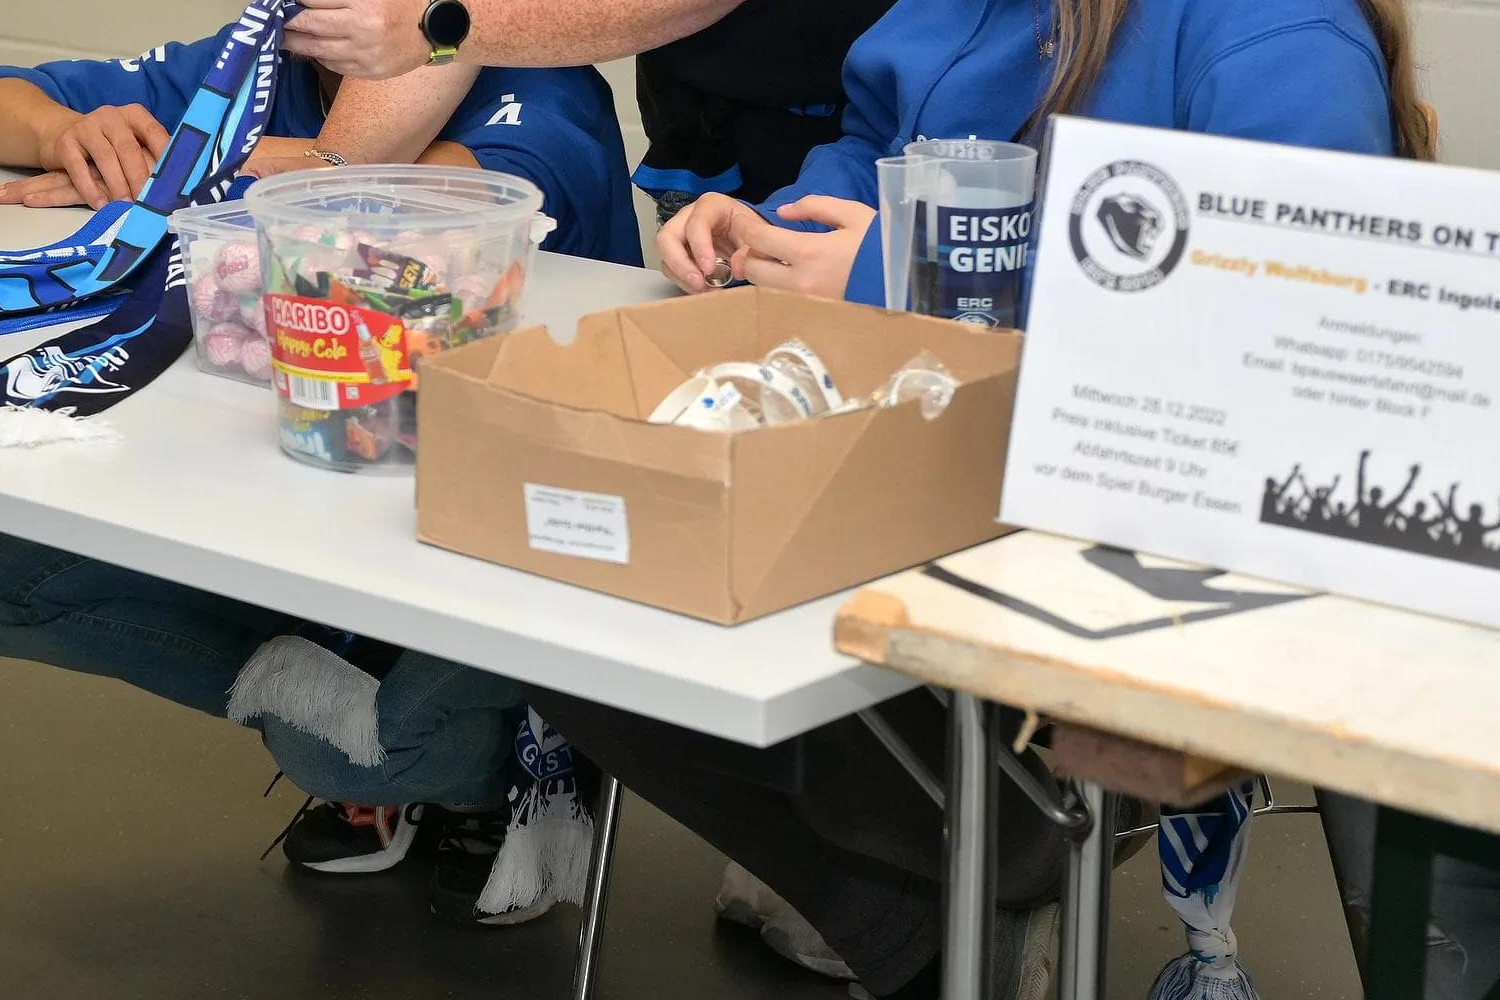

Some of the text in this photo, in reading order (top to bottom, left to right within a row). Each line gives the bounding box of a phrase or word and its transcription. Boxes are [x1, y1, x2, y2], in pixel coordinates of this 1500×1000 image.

[950, 211, 1037, 242] EISKO
[1198, 192, 1268, 220] BLUE
[1276, 202, 1423, 242] PANTHERS
[1432, 225, 1474, 248] ON
[957, 297, 993, 308] ERC
[1388, 278, 1431, 301] ERC
[272, 297, 350, 335] HARIBO
